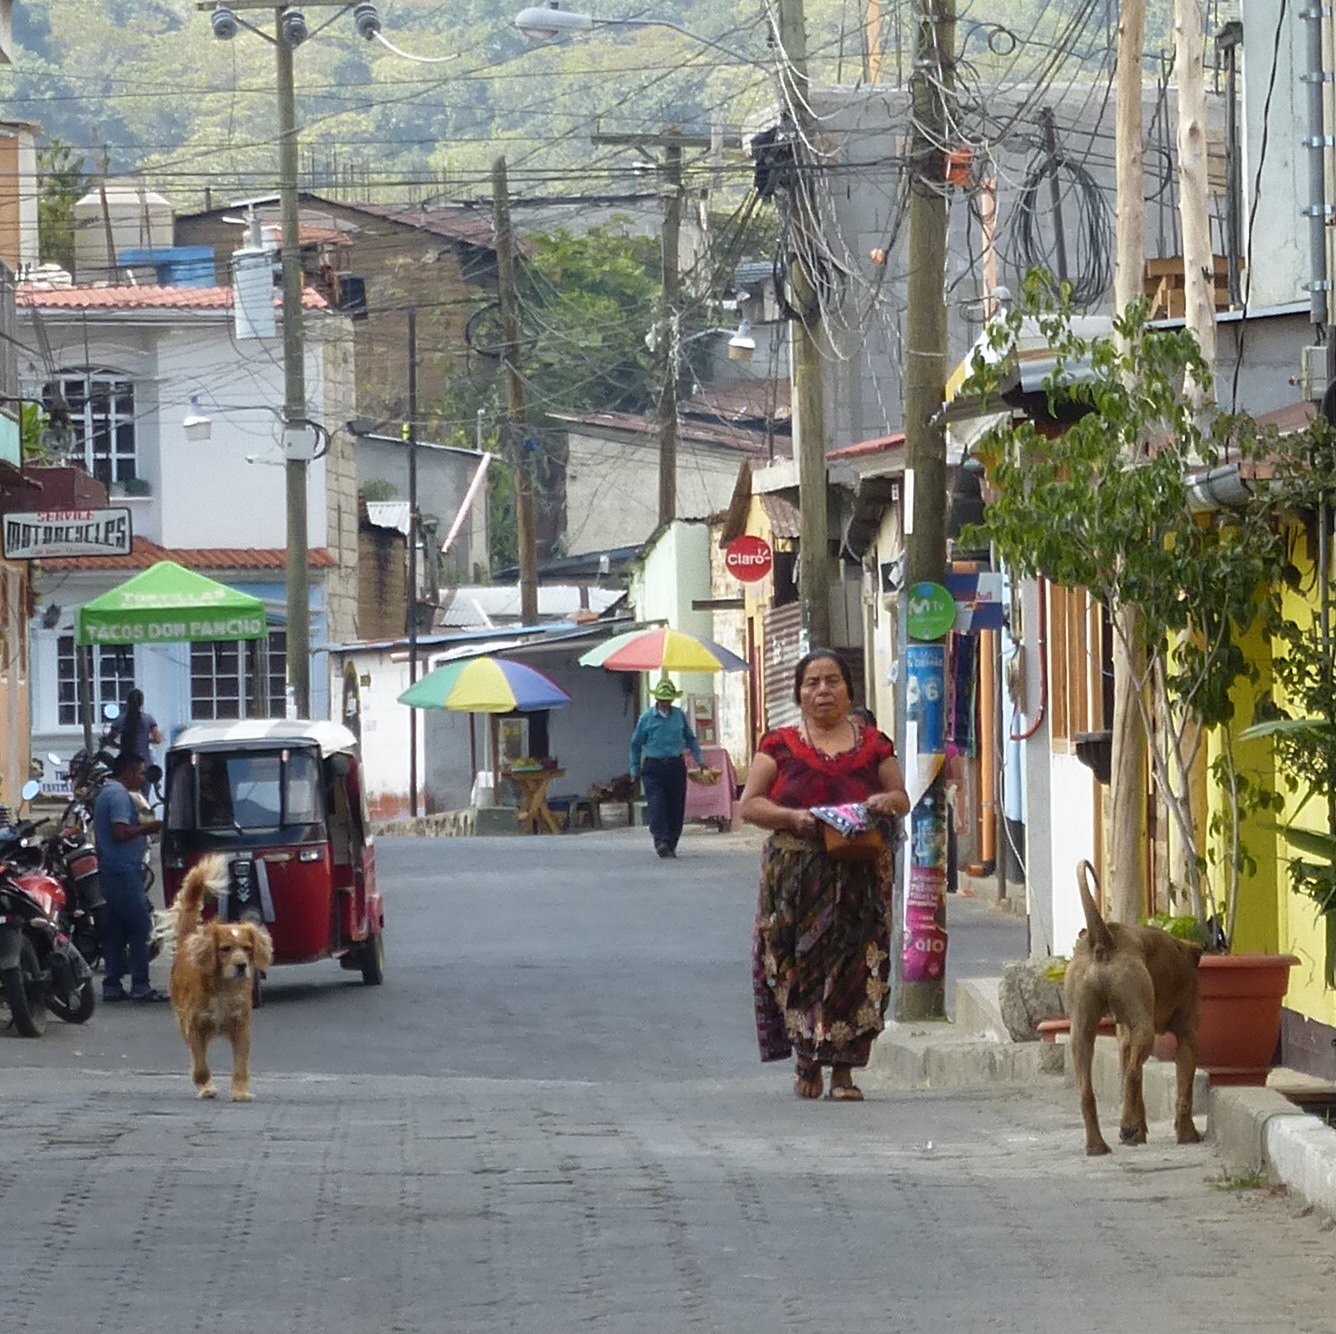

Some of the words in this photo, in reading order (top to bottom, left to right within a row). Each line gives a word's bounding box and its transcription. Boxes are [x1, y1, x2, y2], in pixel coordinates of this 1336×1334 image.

[727, 553, 765, 565] Claro
[86, 624, 144, 640] TACOS
[148, 623, 185, 638] DON
